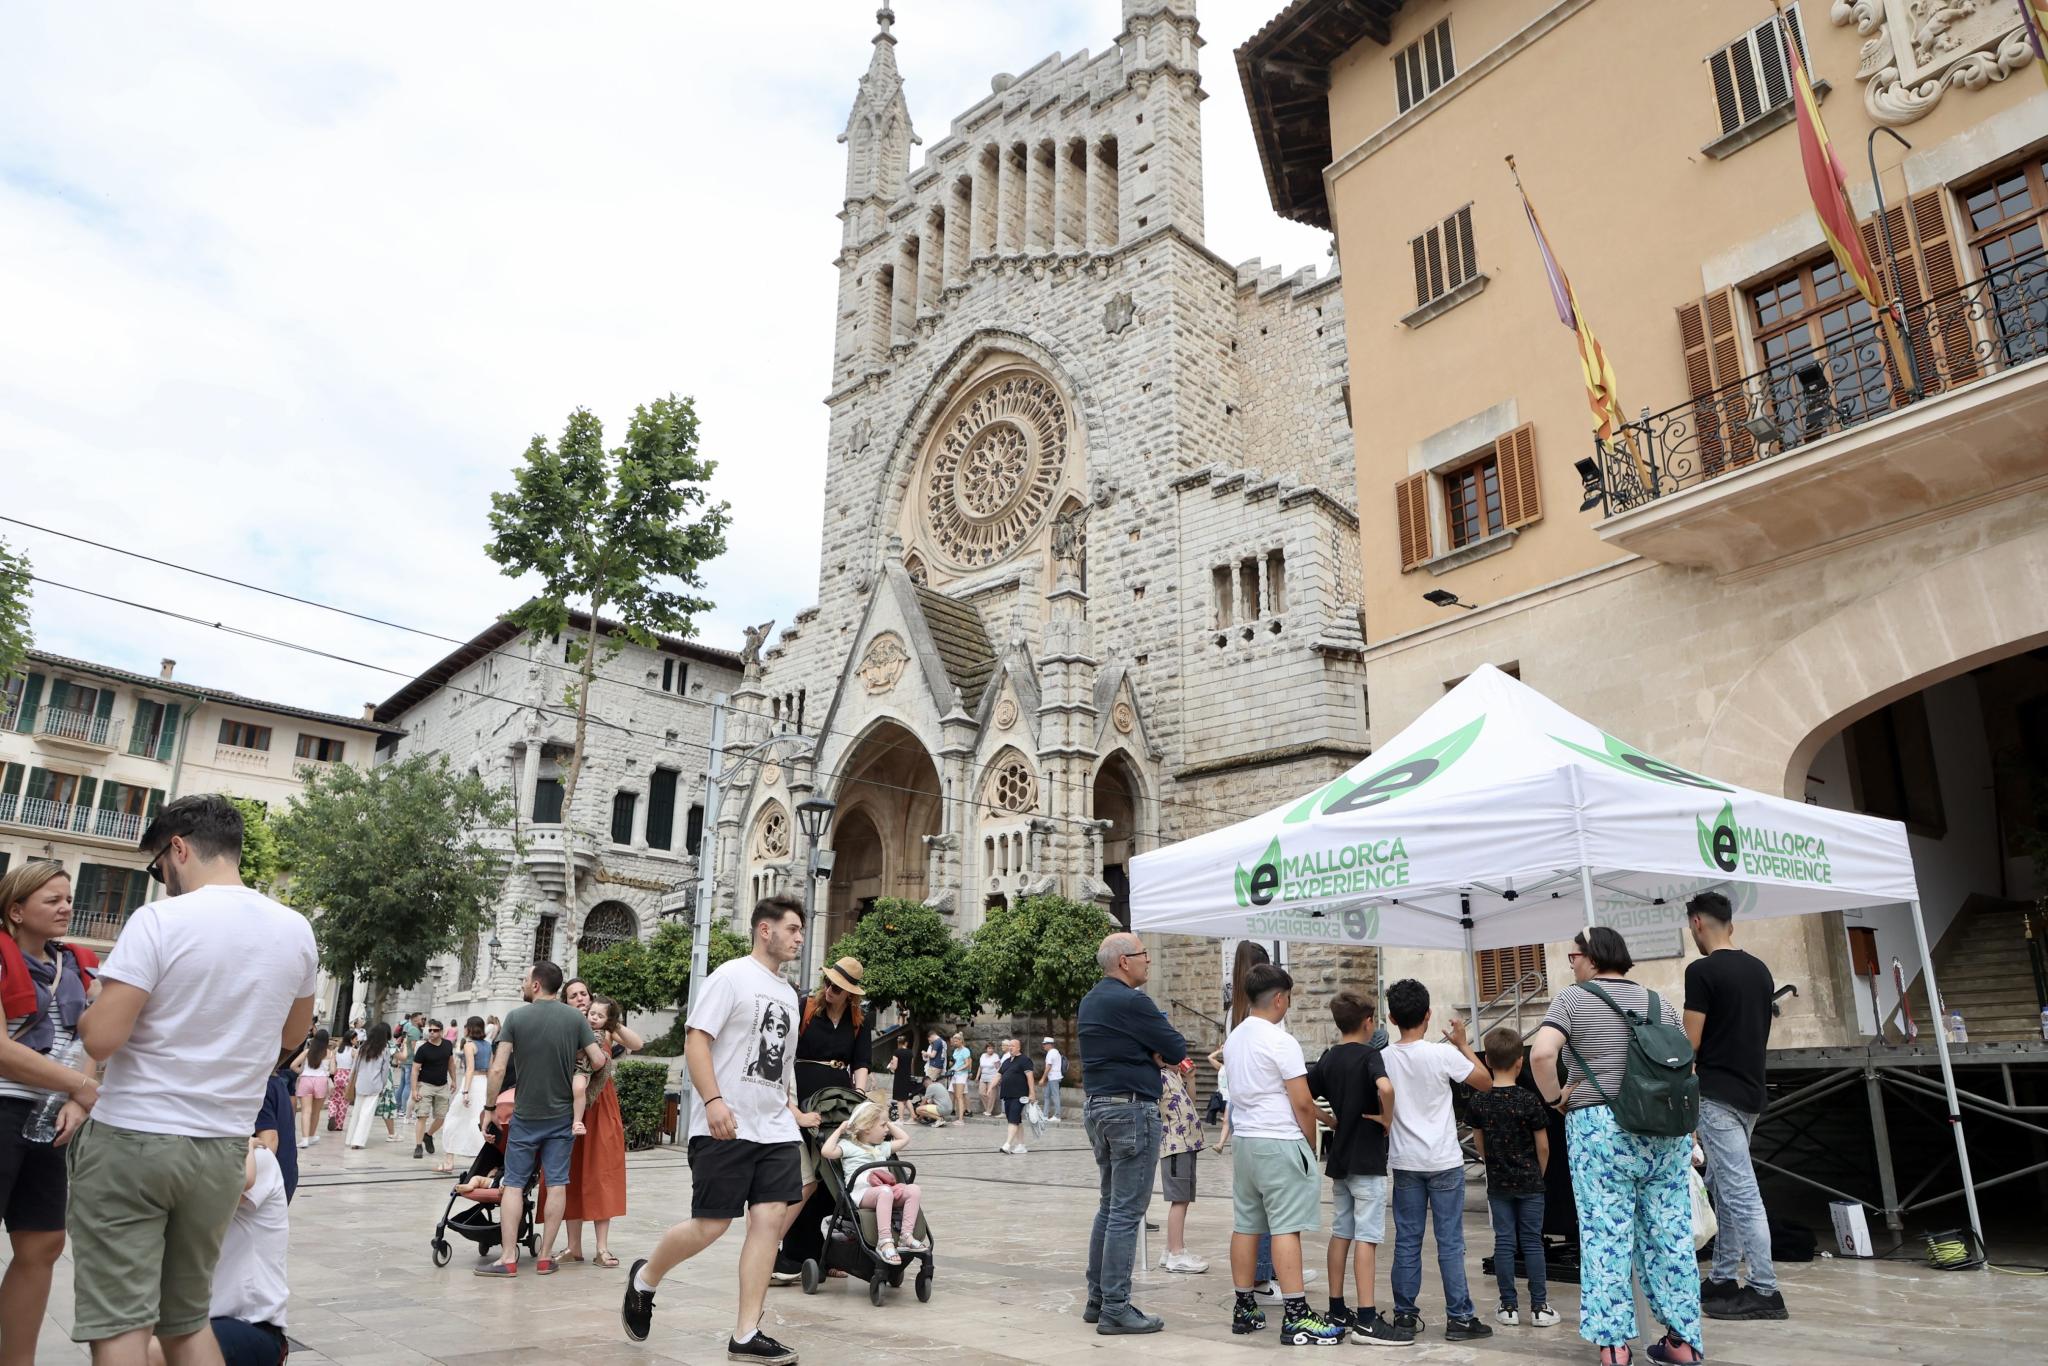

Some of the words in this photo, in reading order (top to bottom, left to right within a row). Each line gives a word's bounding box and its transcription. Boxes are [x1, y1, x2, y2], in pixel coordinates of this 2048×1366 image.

[1283, 836, 1409, 880] MALLORCA
[1739, 826, 1829, 861] MALLORCA
[1283, 863, 1410, 902] EXPERIENCE
[1742, 852, 1832, 884] EXPERIENCE
